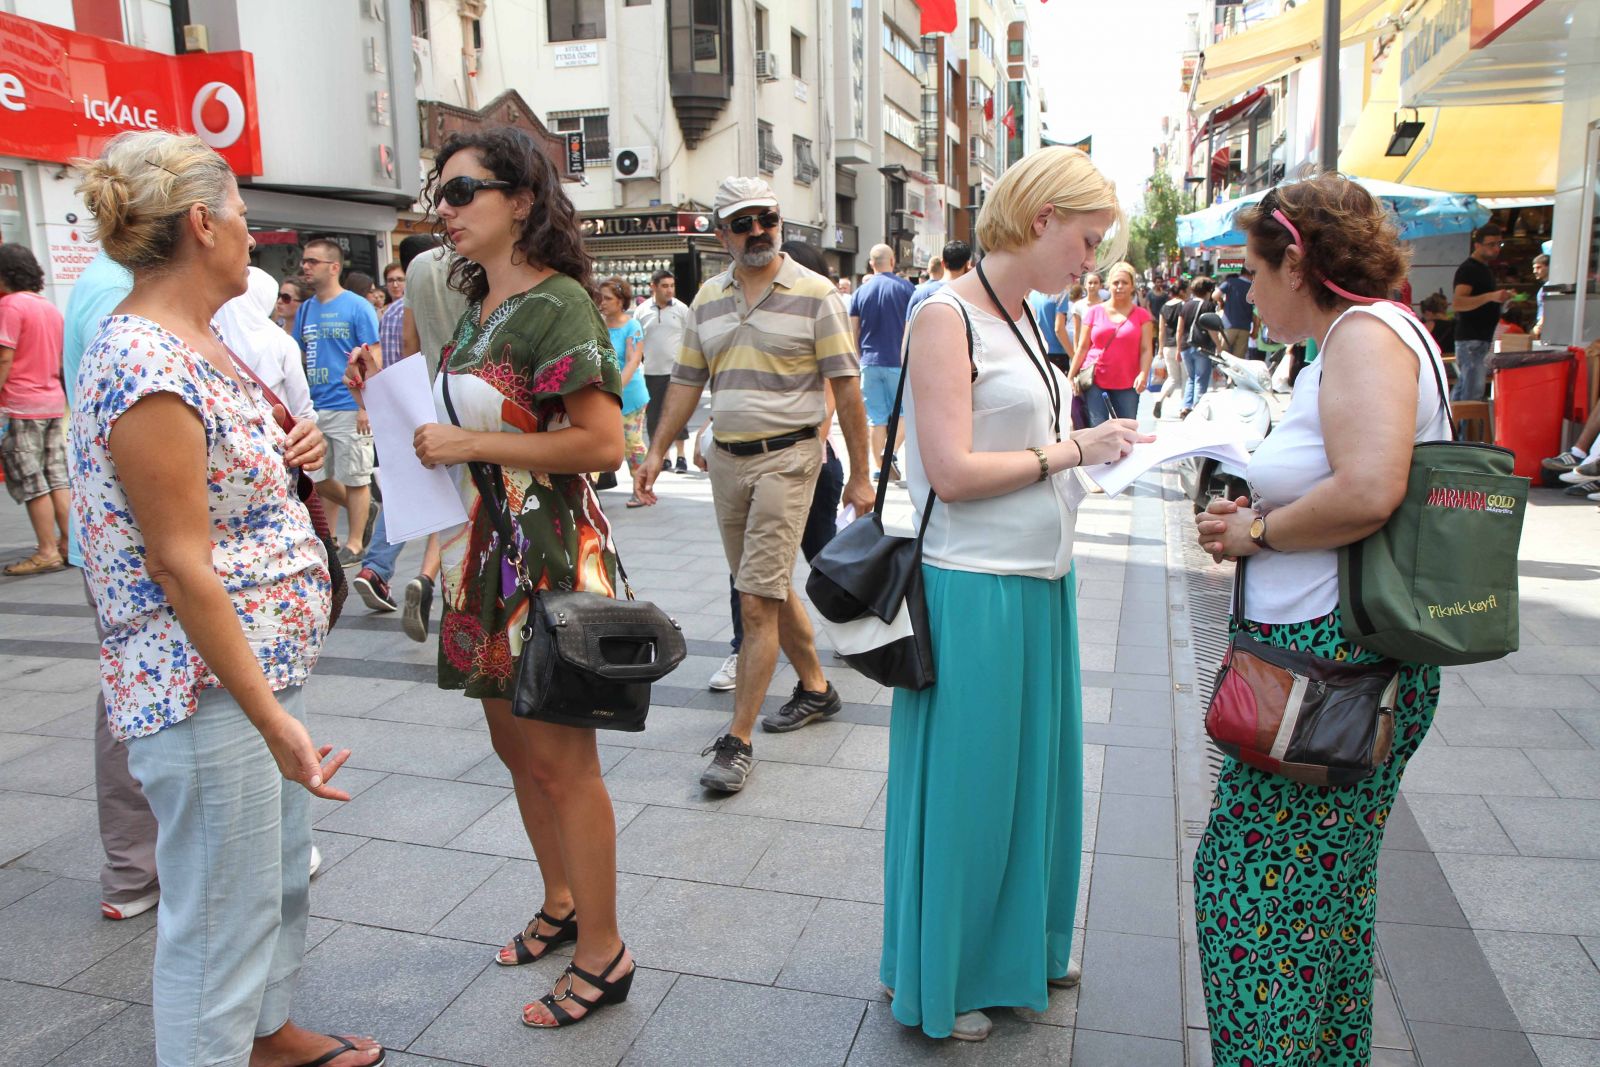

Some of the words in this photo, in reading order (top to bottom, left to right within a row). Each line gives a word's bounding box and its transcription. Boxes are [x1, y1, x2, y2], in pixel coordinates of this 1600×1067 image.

[83, 93, 159, 129] İÇKALE
[595, 216, 671, 235] MURAT
[1427, 487, 1487, 511] MARMARA
[1487, 494, 1516, 509] GOLD
[1428, 601, 1469, 619] Piknik
